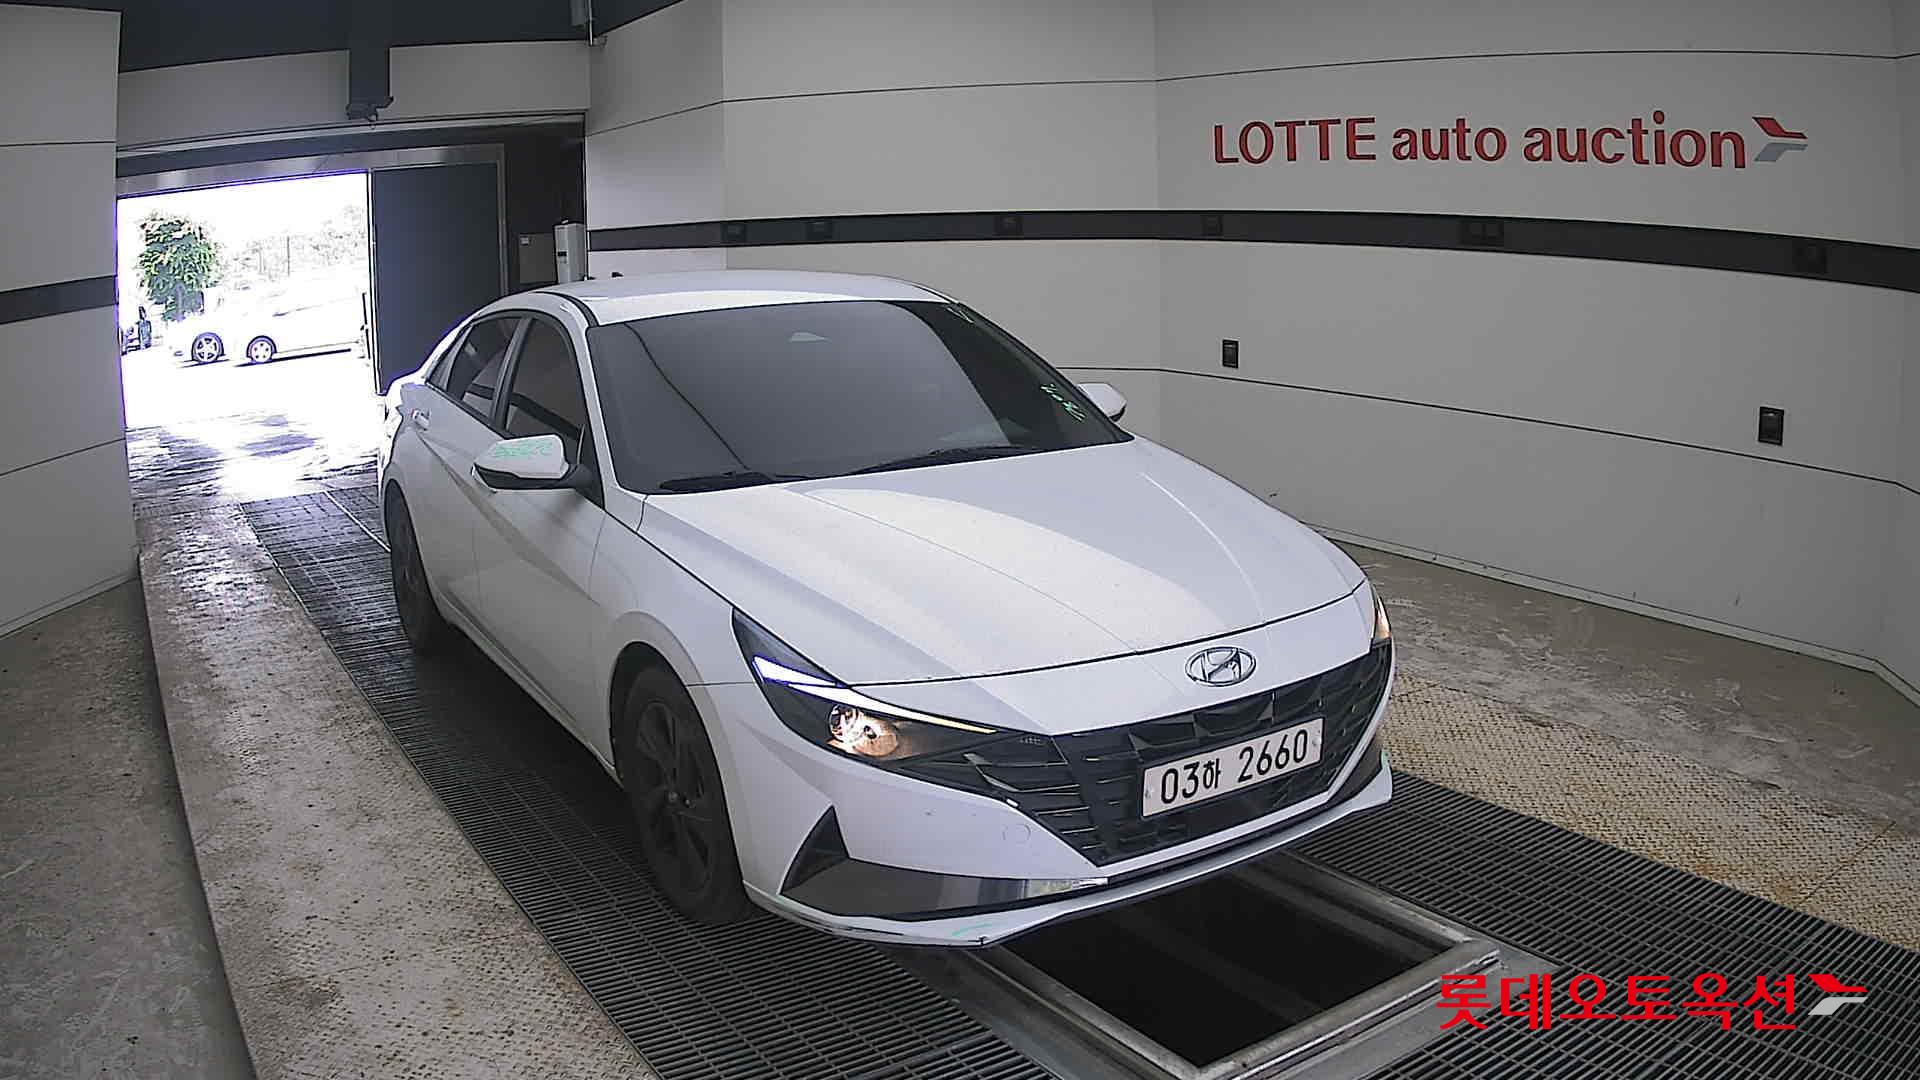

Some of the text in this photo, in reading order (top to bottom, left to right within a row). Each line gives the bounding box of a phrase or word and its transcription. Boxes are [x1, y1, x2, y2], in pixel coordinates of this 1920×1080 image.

[1213, 110, 1747, 169] LOTTE auto auction
[1160, 729, 1308, 804] 03하 2660
